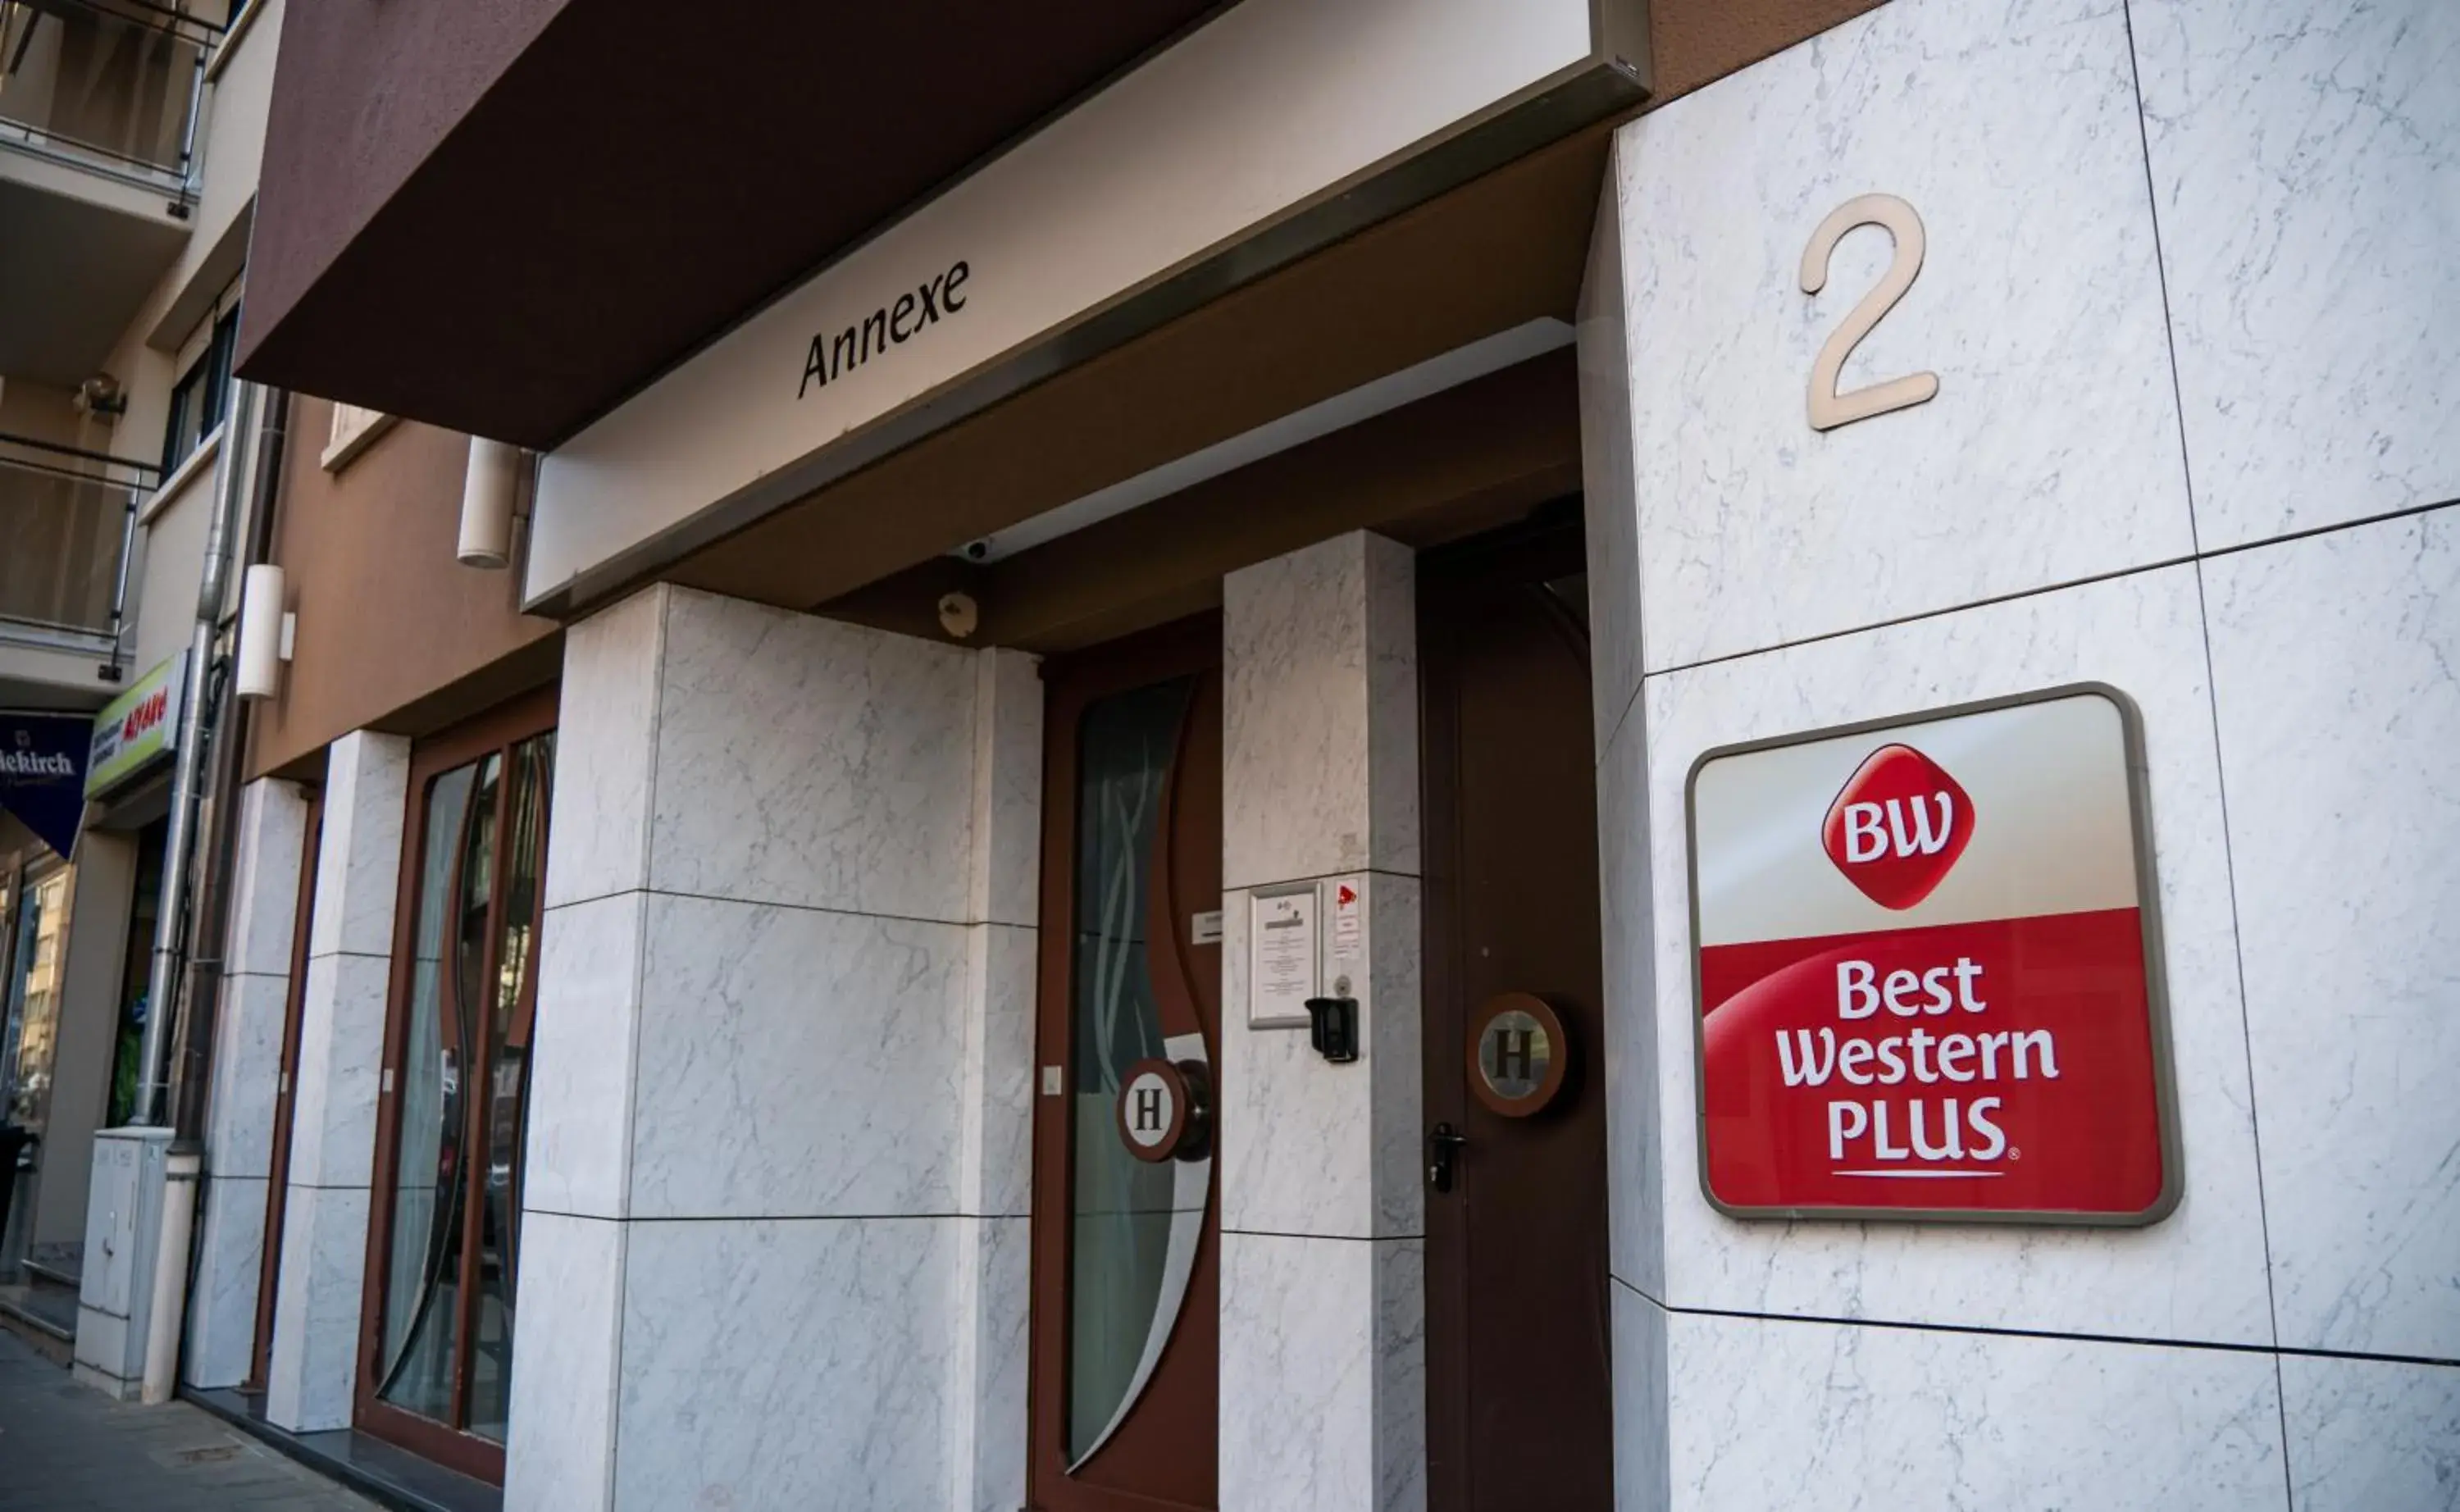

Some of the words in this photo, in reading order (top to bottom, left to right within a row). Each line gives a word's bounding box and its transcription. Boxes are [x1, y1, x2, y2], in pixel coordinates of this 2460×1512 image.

[796, 260, 969, 400] Annexe
[1799, 193, 1940, 432] 2
[1843, 790, 1953, 864] BW
[1836, 956, 1987, 1020] Best
[1492, 1028, 1534, 1080] H
[1775, 1027, 2060, 1088] Western
[1134, 1088, 1164, 1131] H
[1827, 1096, 2007, 1161] PLUS
